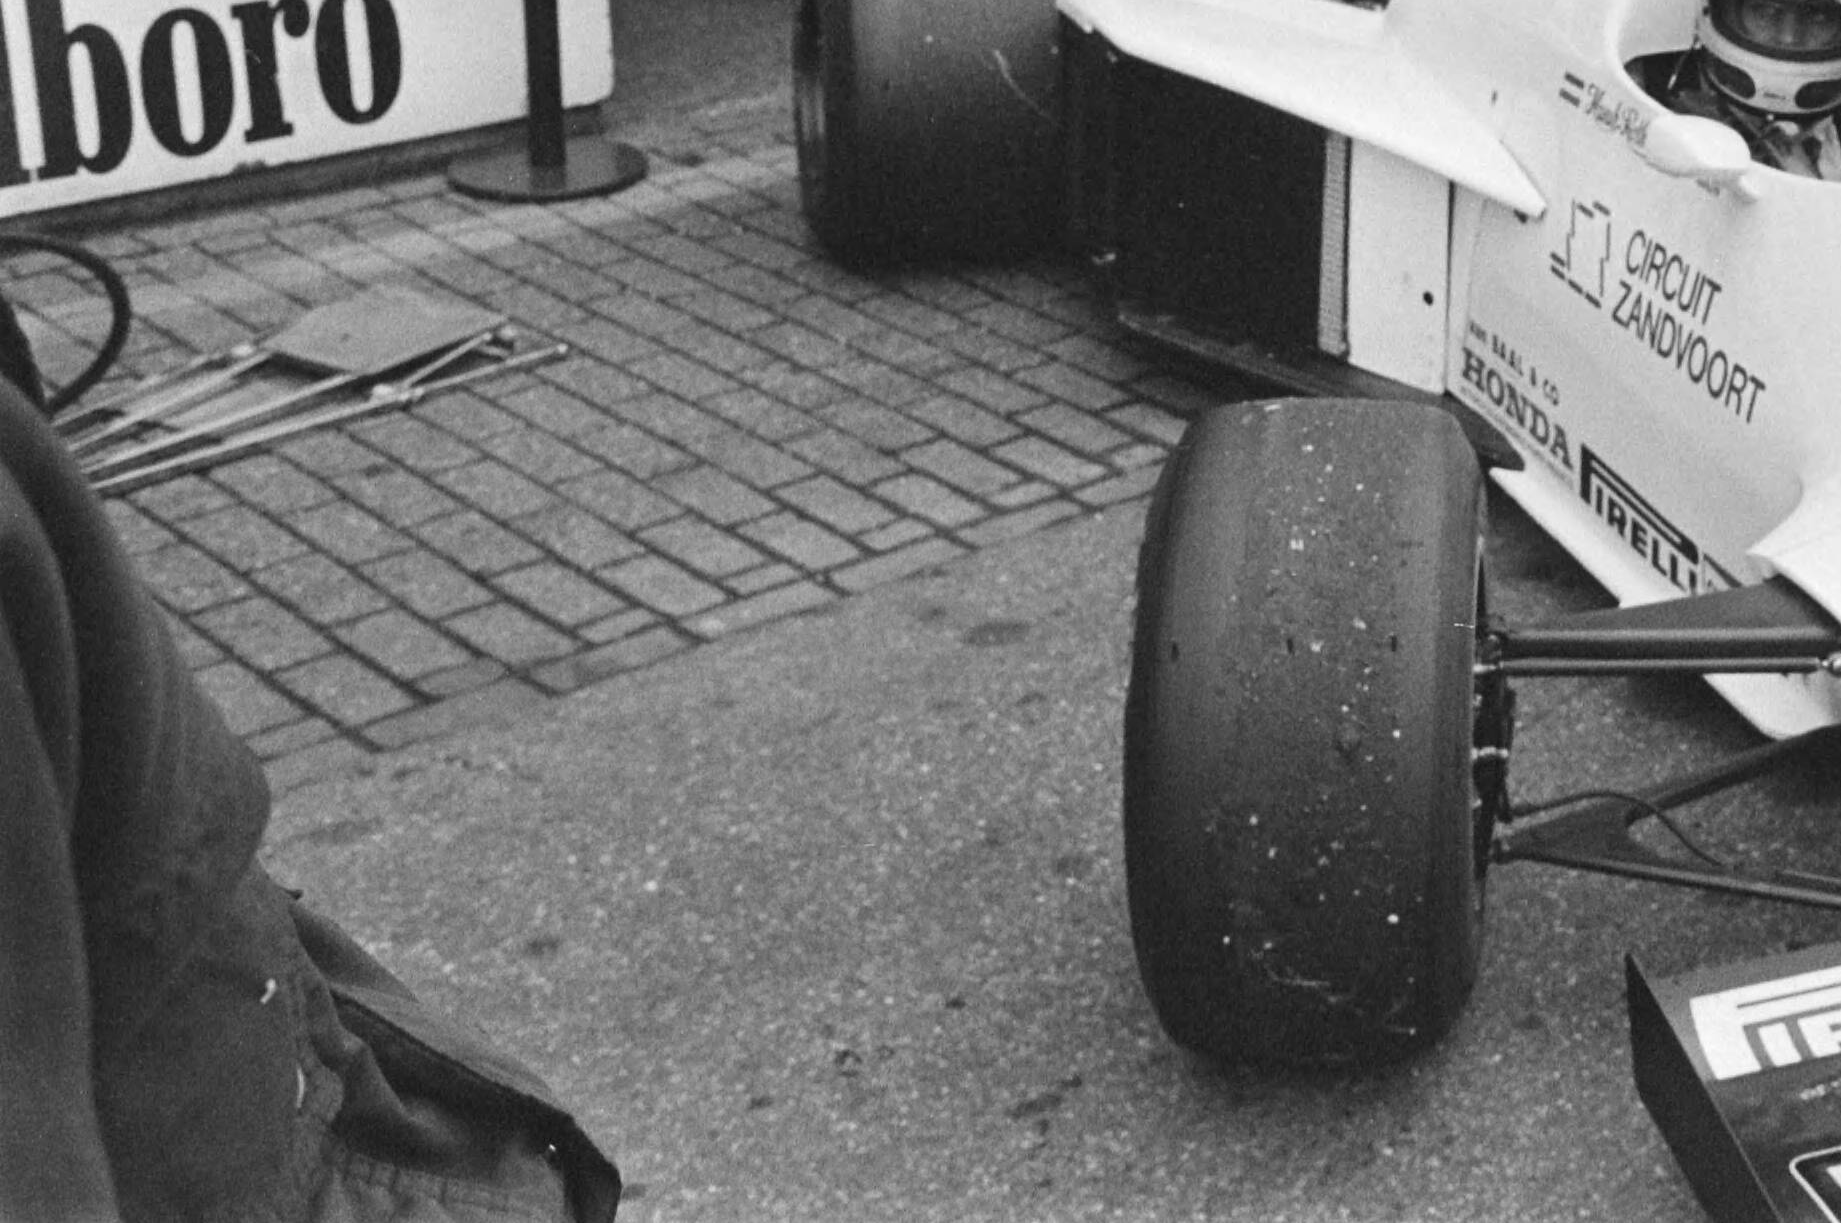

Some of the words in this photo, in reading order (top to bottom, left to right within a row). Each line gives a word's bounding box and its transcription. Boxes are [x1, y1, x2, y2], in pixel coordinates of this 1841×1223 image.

[1625, 229, 1723, 326] CIRCUIT
[1462, 346, 1574, 470] HONDA
[1611, 278, 1767, 424] ZANDVOORT
[1579, 443, 1699, 596] PIRELLI
